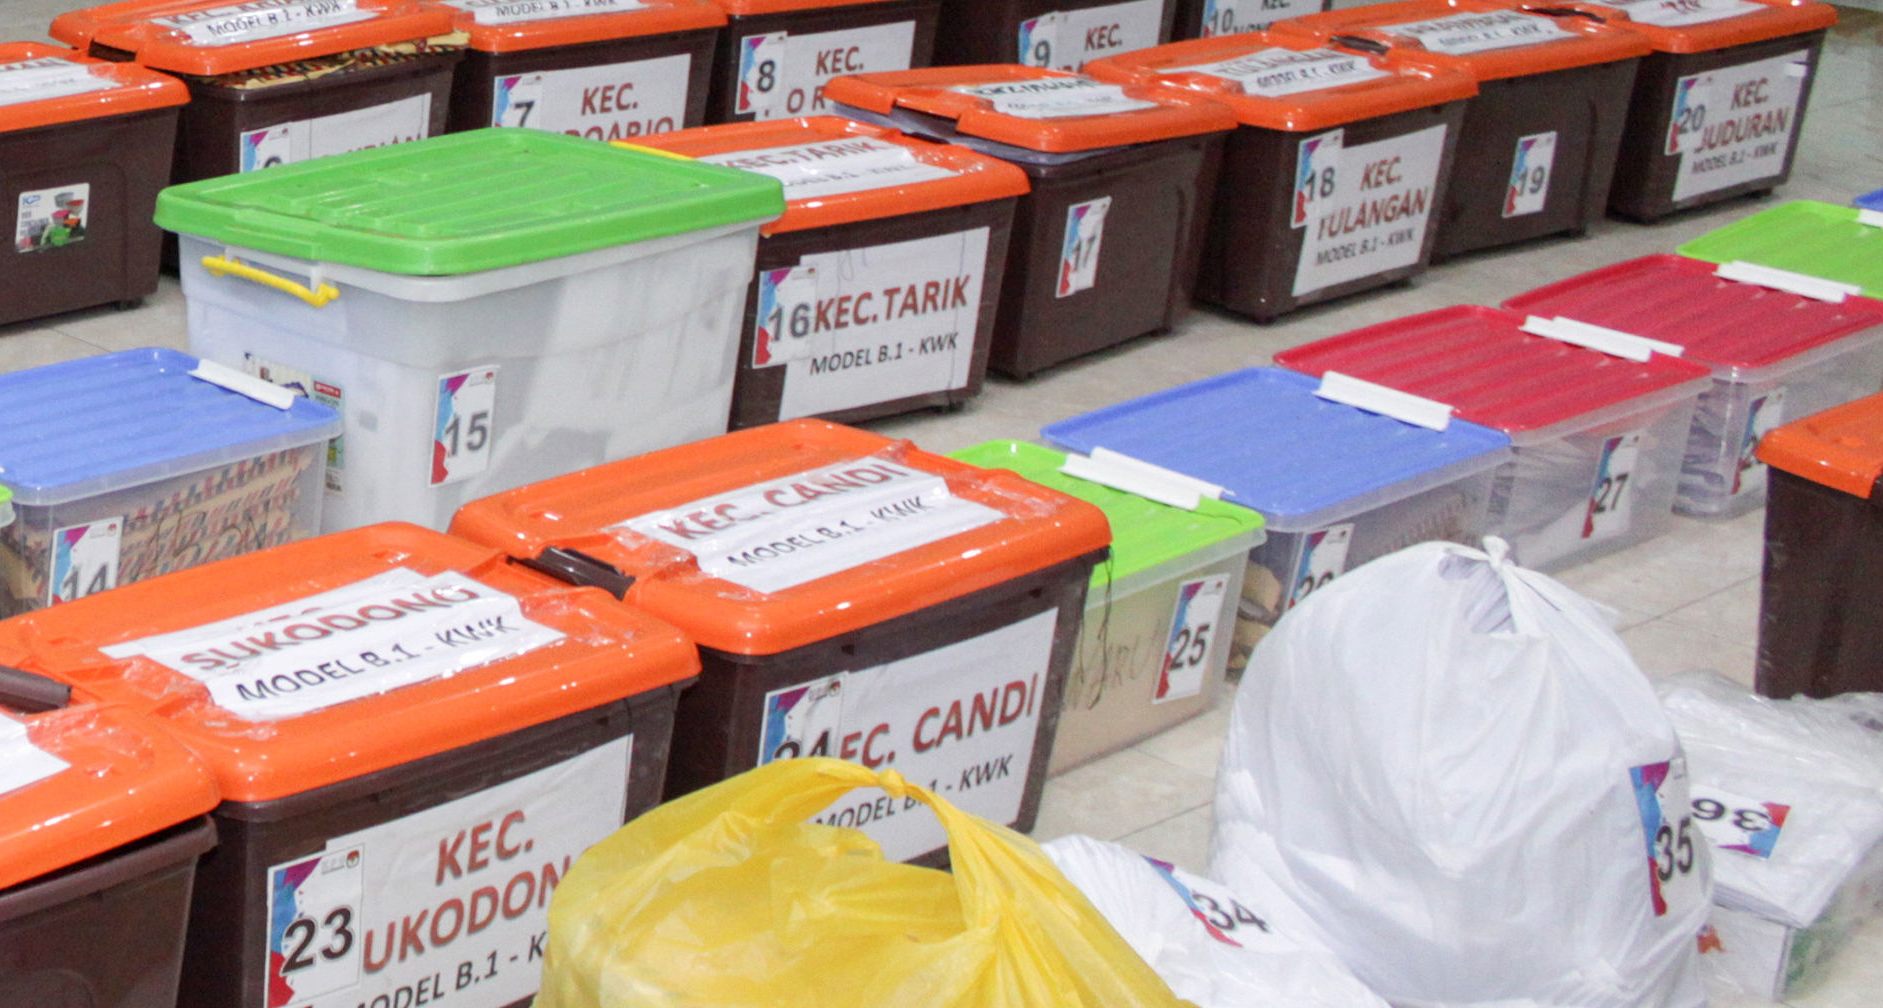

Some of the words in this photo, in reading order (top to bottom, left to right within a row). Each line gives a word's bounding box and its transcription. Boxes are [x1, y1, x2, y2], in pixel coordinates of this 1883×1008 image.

[1033, 39, 1051, 68] 9
[1083, 24, 1123, 52] KEC.
[756, 60, 776, 93] 8
[815, 46, 865, 76] KEC.
[513, 99, 535, 128] 7
[580, 82, 639, 116] KEC.
[1677, 103, 1706, 135] 20
[1693, 106, 1789, 154] UDURAN
[1304, 166, 1335, 202] 18
[1517, 165, 1545, 197] 19
[768, 302, 811, 342] 16
[813, 274, 972, 334] KEC.TARIK
[809, 349, 872, 377] MODEL
[877, 340, 904, 363] B.1
[918, 331, 959, 355] KWK
[444, 409, 489, 457] 15
[774, 463, 911, 510] CANDI
[1592, 471, 1629, 513] 27
[727, 528, 826, 569] MODEL
[62, 563, 108, 599] 14
[180, 584, 483, 671] SUKODONG
[1170, 622, 1211, 672] 25
[235, 658, 364, 703] MODEL
[359, 642, 421, 667] B.1
[433, 613, 520, 648] KWK
[840, 722, 896, 769] EC.
[912, 672, 1039, 754] CANDI
[959, 754, 1014, 793] KWK
[435, 810, 535, 886] KEC.
[1655, 815, 1694, 882] 35
[363, 853, 572, 975] UKODON
[1190, 889, 1270, 933] 34
[280, 904, 354, 977] 23
[356, 972, 445, 1008] ODEL
[454, 949, 499, 991] B.1
